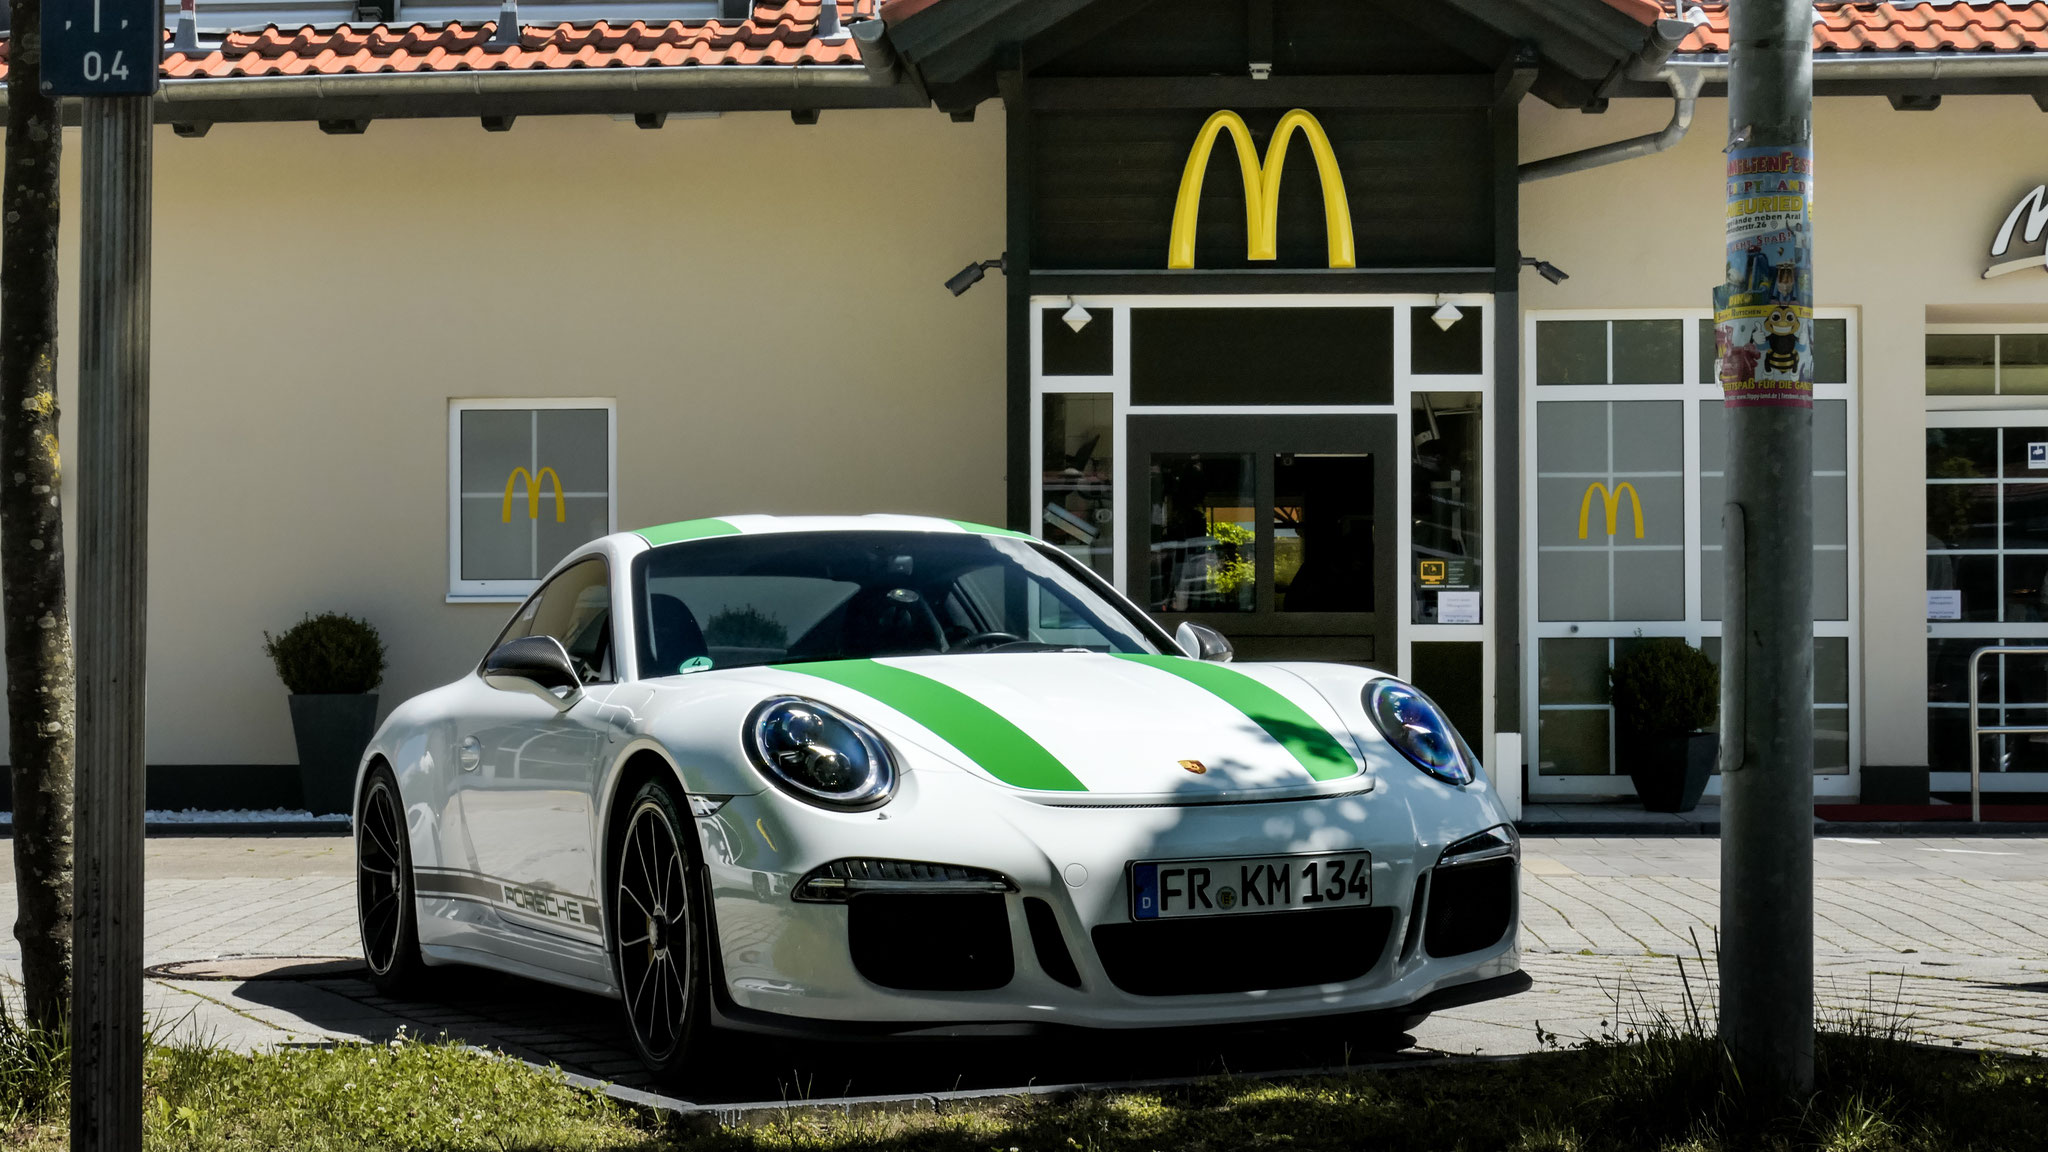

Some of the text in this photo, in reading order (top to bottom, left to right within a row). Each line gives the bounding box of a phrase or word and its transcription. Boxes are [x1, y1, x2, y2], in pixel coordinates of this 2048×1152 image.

[83, 50, 129, 82] 0,4
[1754, 214, 1782, 222] neben
[1778, 381, 1793, 389] DIE
[692, 657, 702, 667] 4
[1160, 858, 1368, 911] FR KM 134
[503, 885, 582, 923] PORSCHE
[1142, 896, 1150, 909] D
